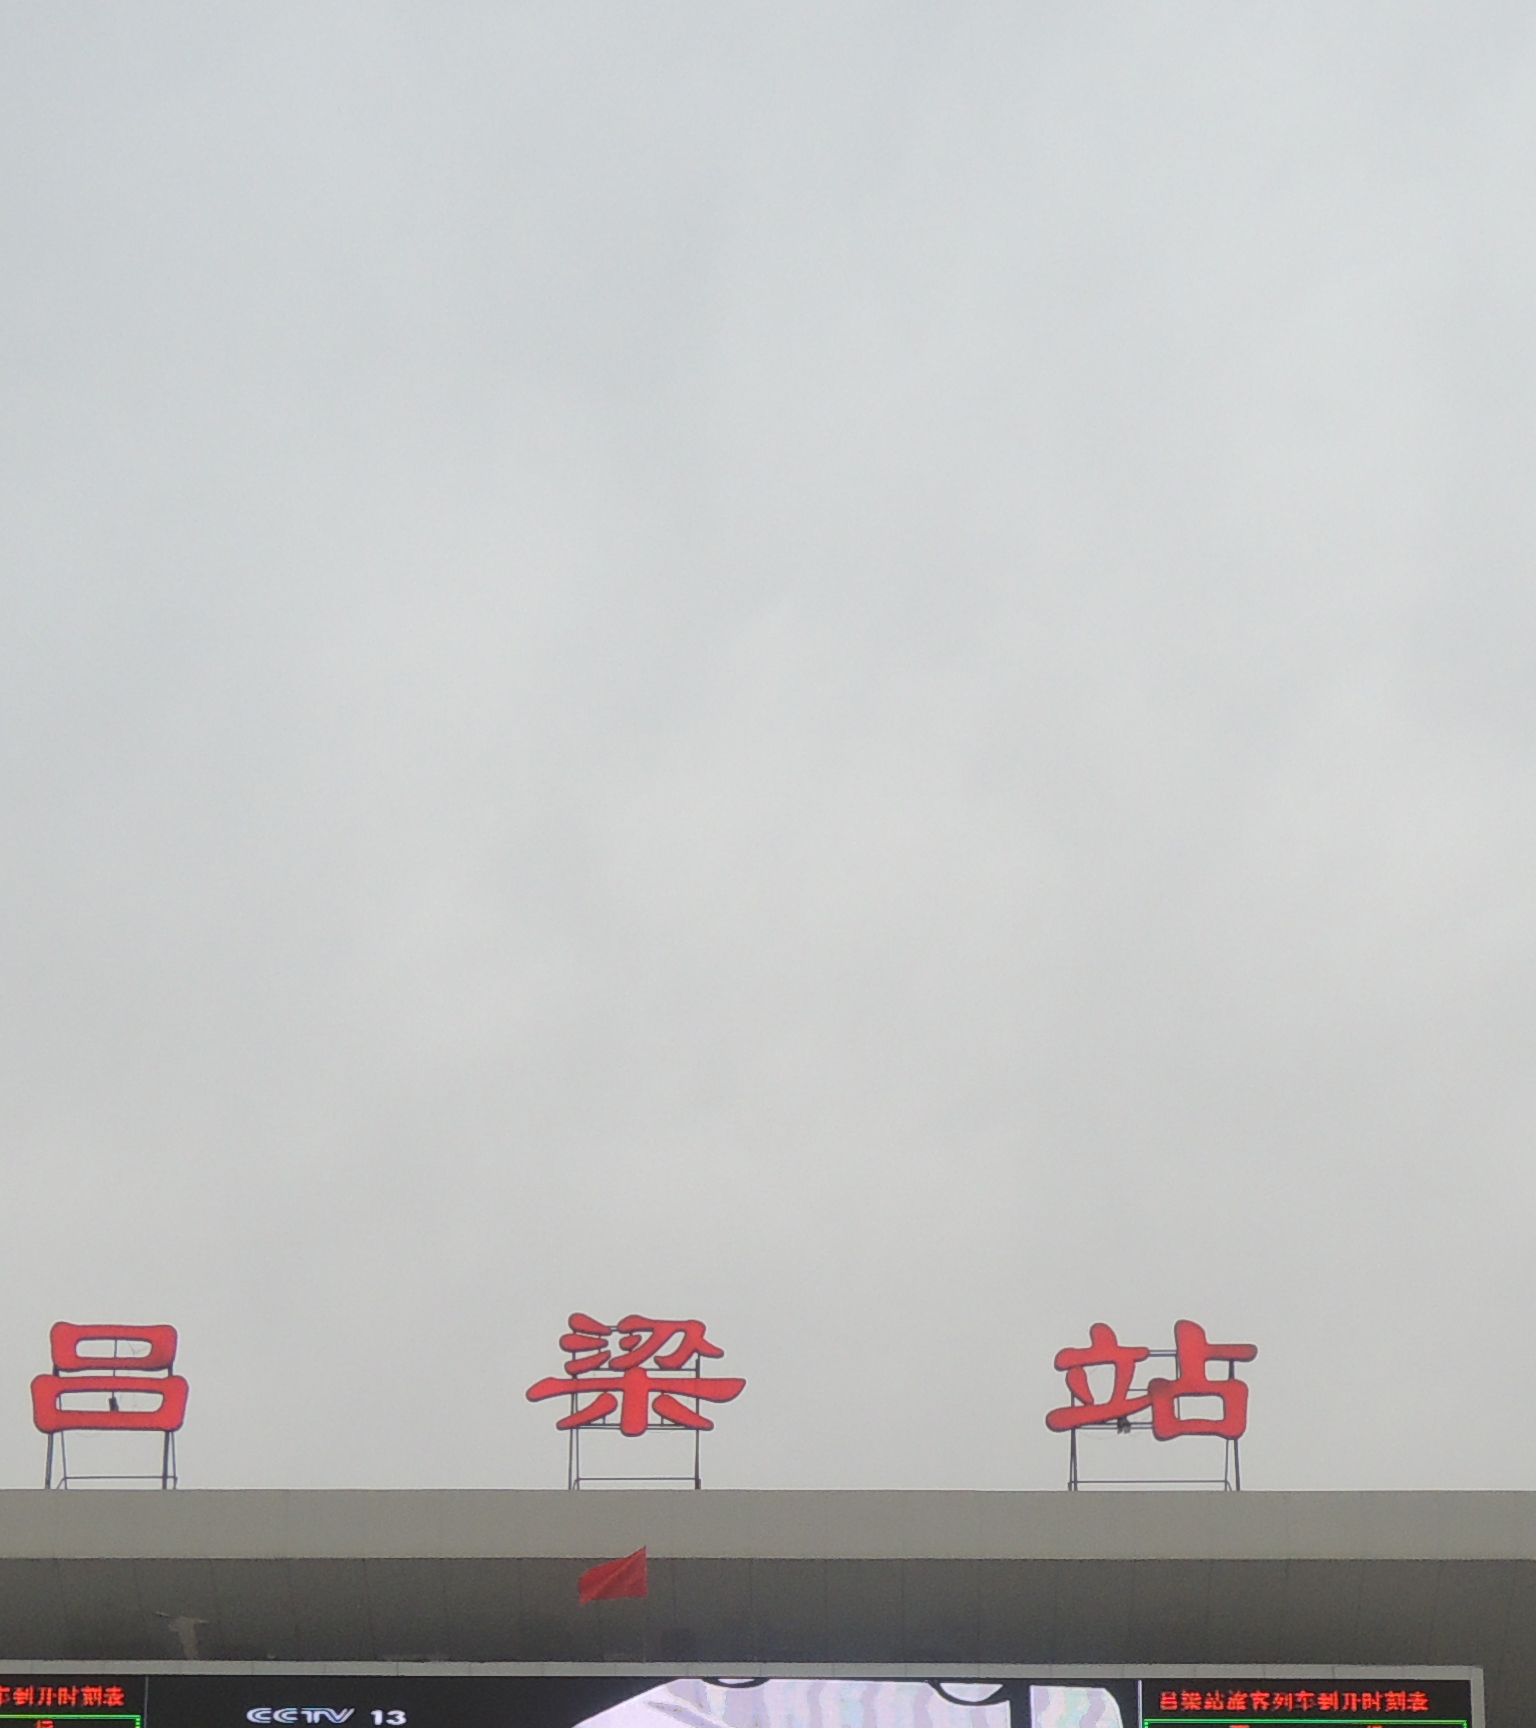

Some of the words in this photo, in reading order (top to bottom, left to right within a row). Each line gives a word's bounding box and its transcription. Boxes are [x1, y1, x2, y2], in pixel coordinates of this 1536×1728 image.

[30, 1319, 1259, 1440] 吕梁站
[245, 1707, 355, 1724] CCTV
[369, 1709, 407, 1726] 13
